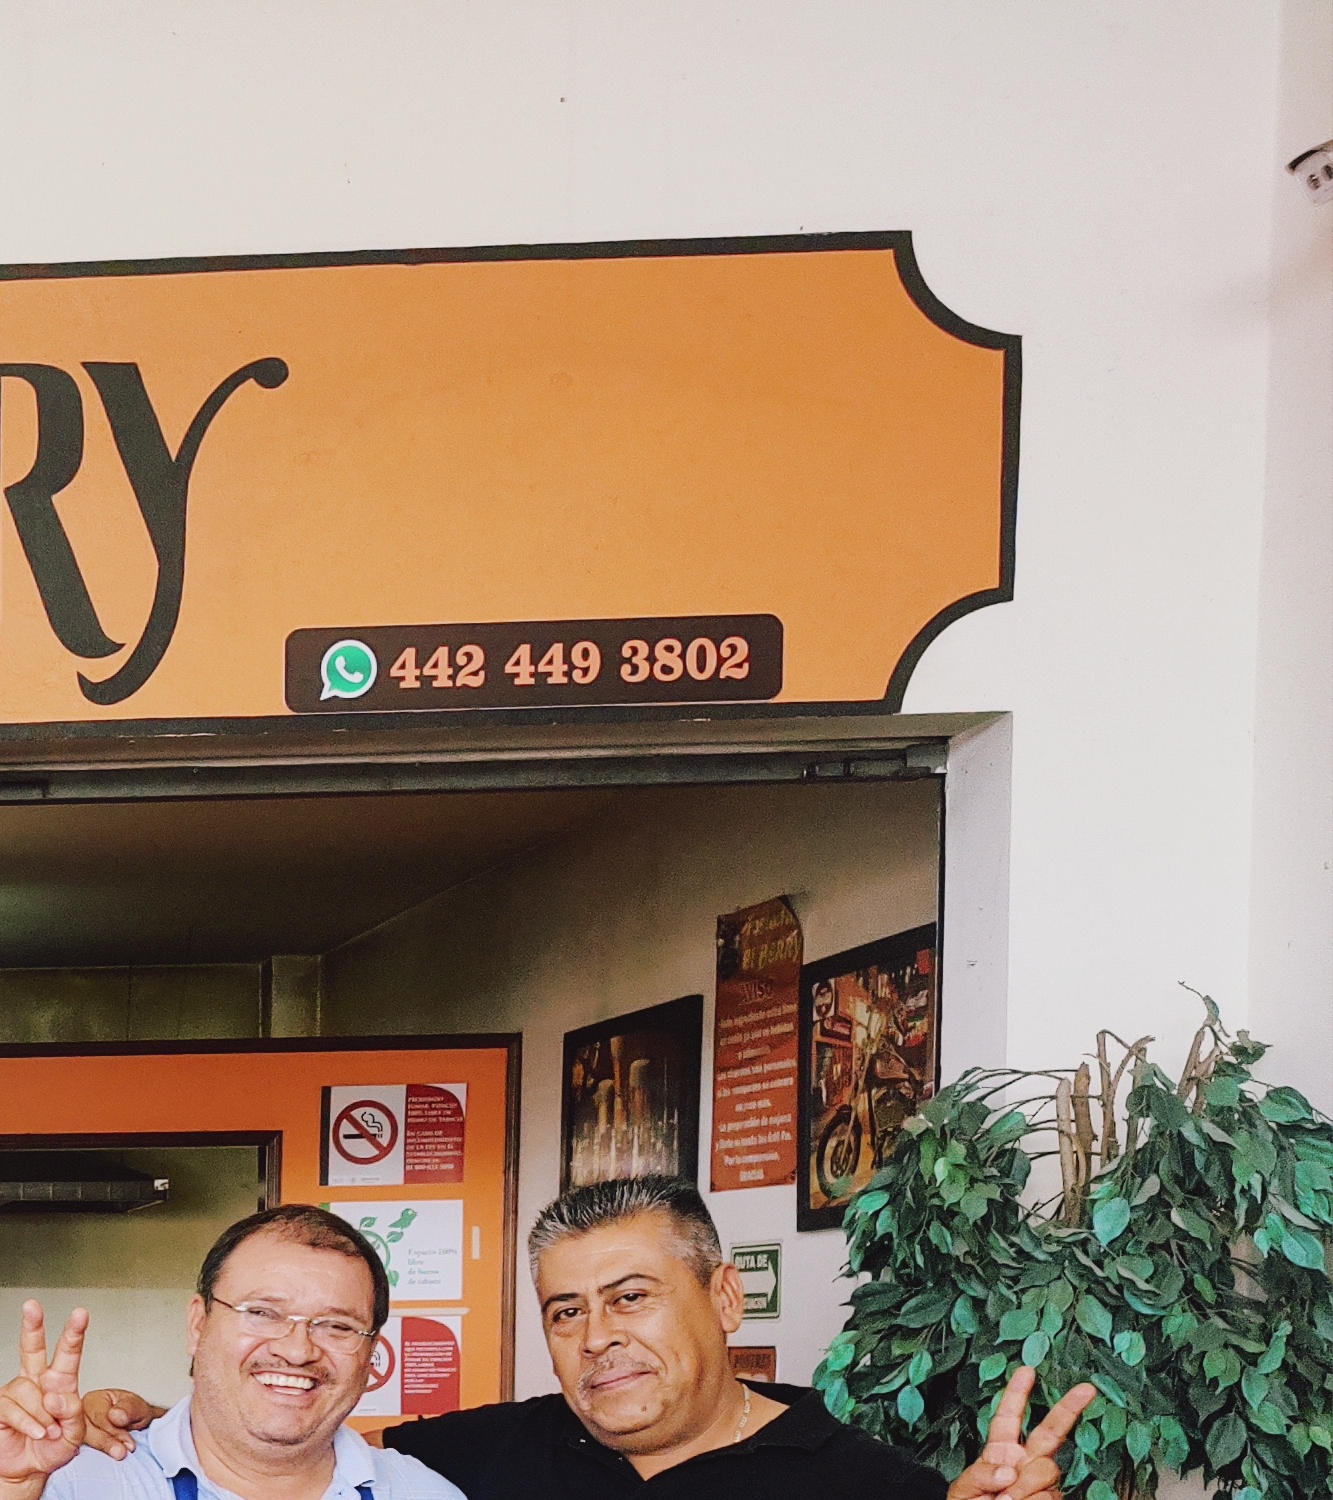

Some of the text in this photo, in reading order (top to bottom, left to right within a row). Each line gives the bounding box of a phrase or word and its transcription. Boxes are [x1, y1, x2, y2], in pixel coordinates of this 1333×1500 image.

[390, 637, 750, 689] 442 449 3802
[757, 1254, 768, 1268] DE
